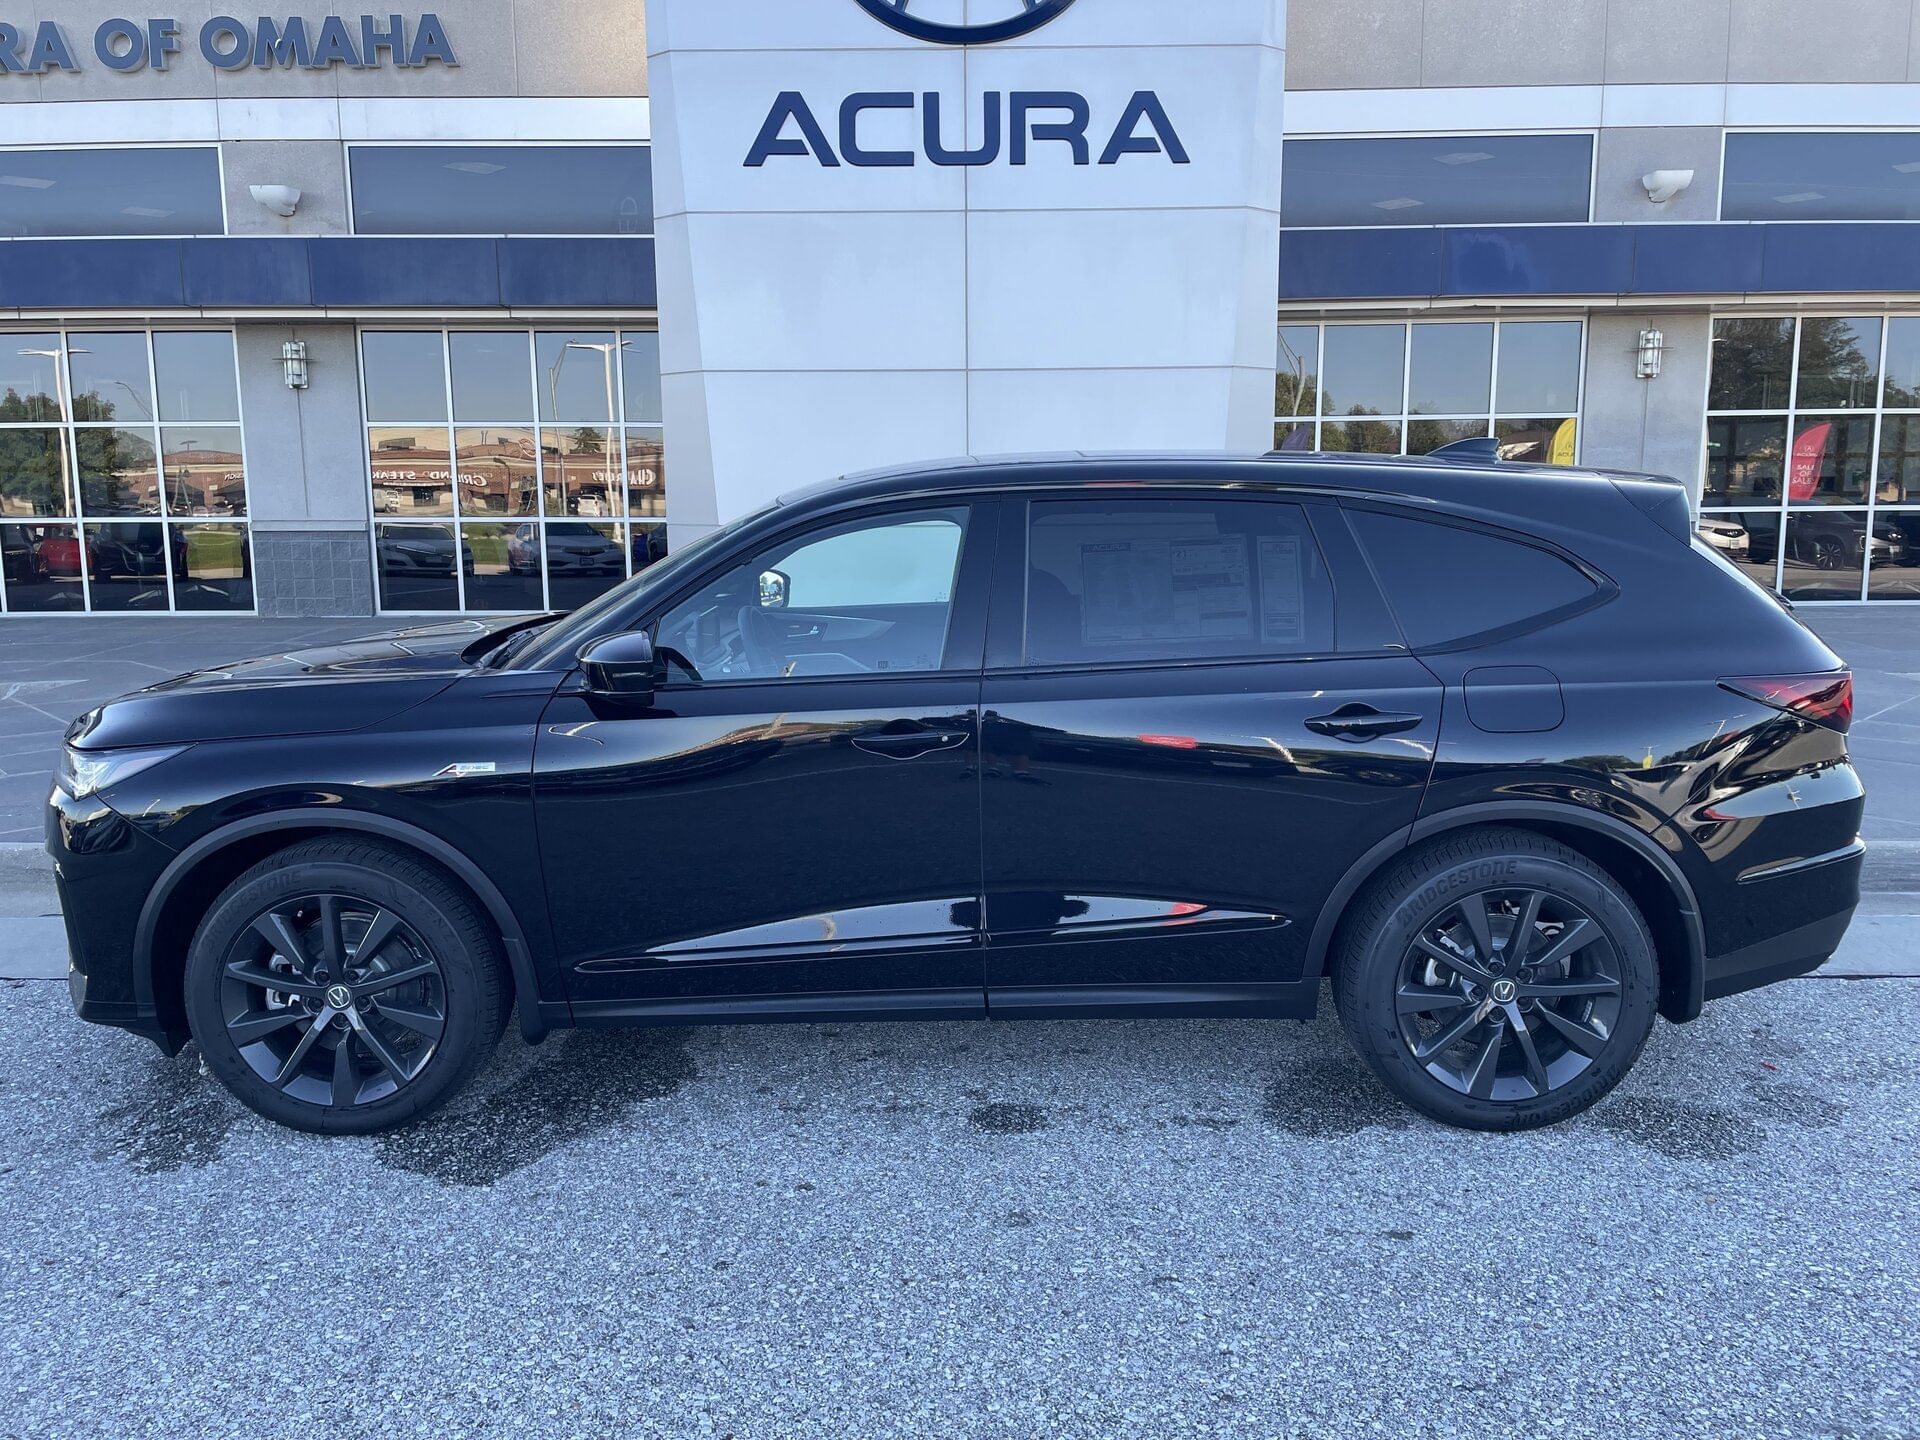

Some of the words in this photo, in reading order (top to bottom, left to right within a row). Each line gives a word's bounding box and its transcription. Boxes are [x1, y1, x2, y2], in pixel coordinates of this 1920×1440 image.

[93, 17, 180, 71] OF
[199, 13, 460, 70] OMAHA
[742, 90, 1191, 167] ACURA
[1395, 860, 1518, 928] BRIDGESTONE
